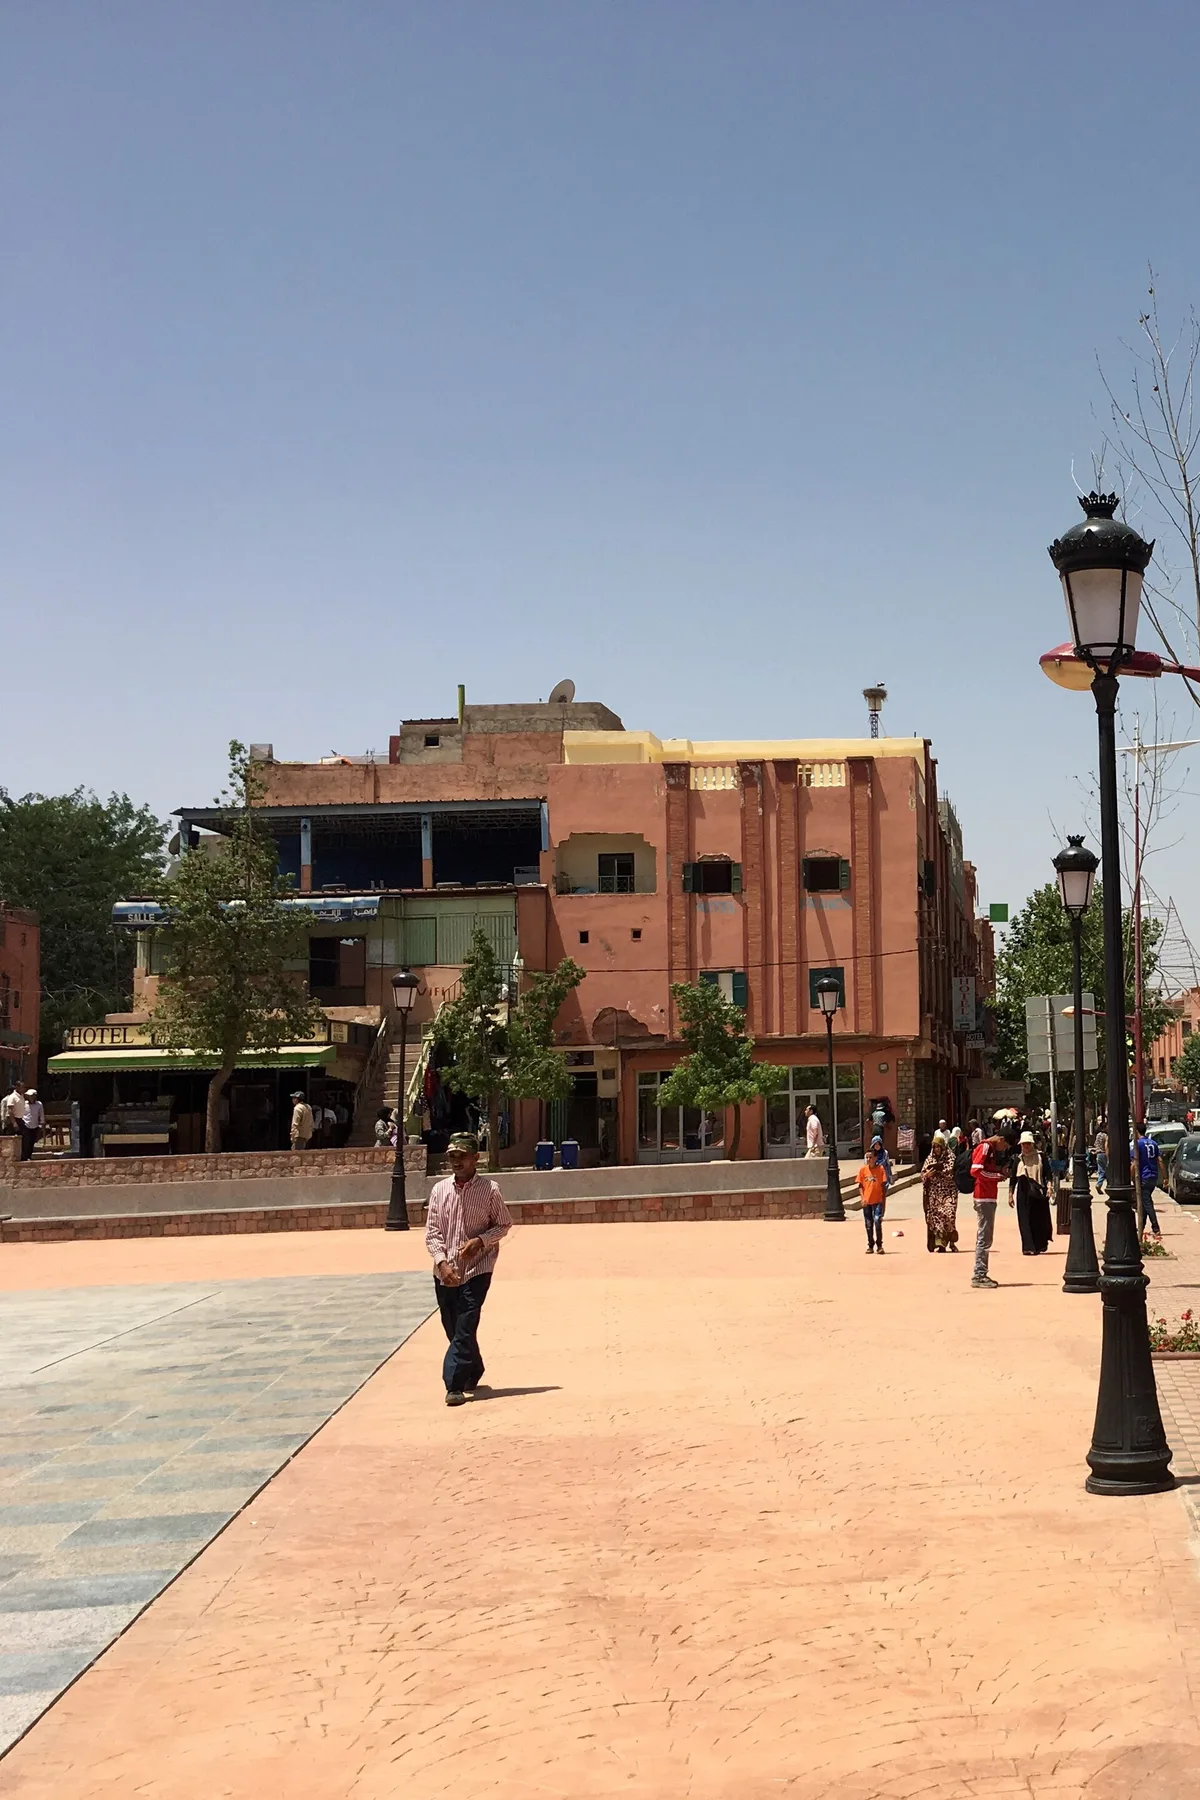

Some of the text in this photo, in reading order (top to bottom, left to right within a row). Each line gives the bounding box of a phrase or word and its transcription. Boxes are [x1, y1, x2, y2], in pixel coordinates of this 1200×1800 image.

[127, 913, 155, 923] SALLE
[959, 978, 970, 1015] HOTEL
[70, 1027, 134, 1045] HOTEL
[966, 1033, 984, 1041] HOTEL
